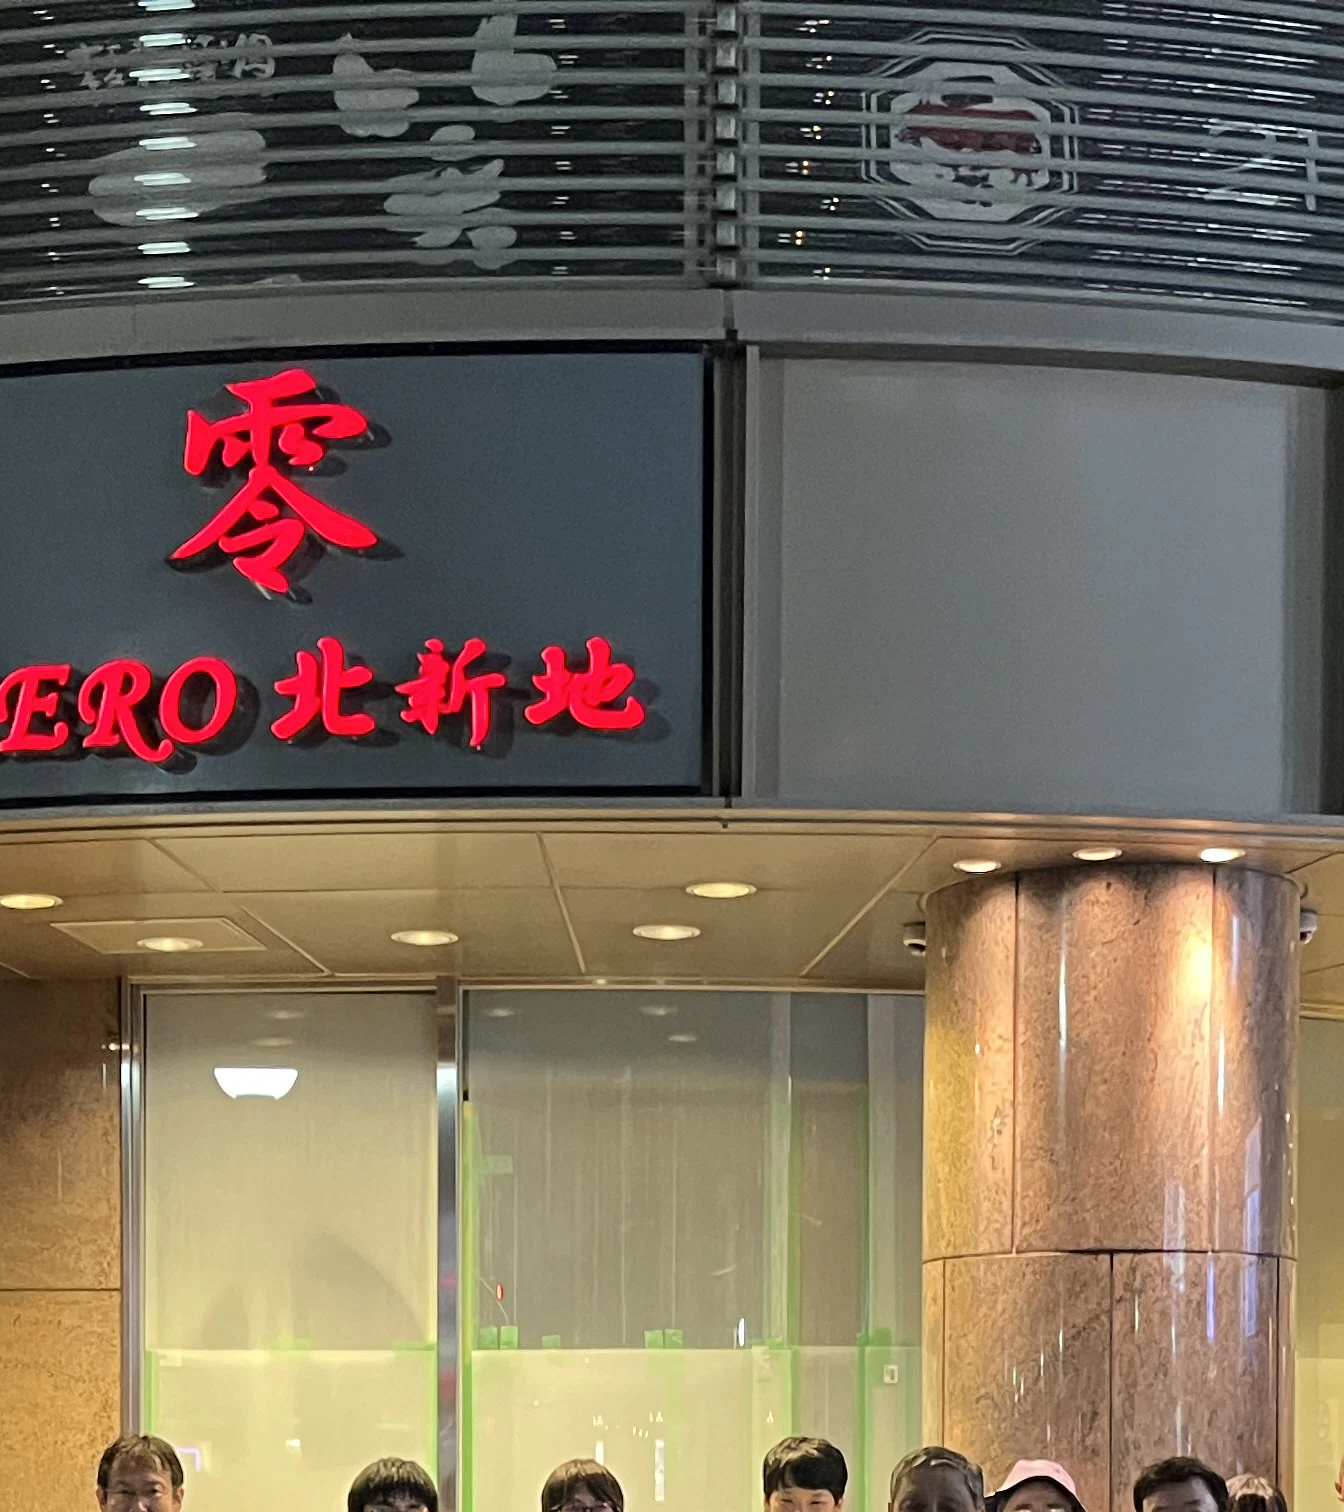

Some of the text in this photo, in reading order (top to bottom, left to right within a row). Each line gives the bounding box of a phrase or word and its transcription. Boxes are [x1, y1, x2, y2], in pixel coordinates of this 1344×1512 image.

[169, 367, 379, 594] 零
[269, 636, 646, 749] 北新地
